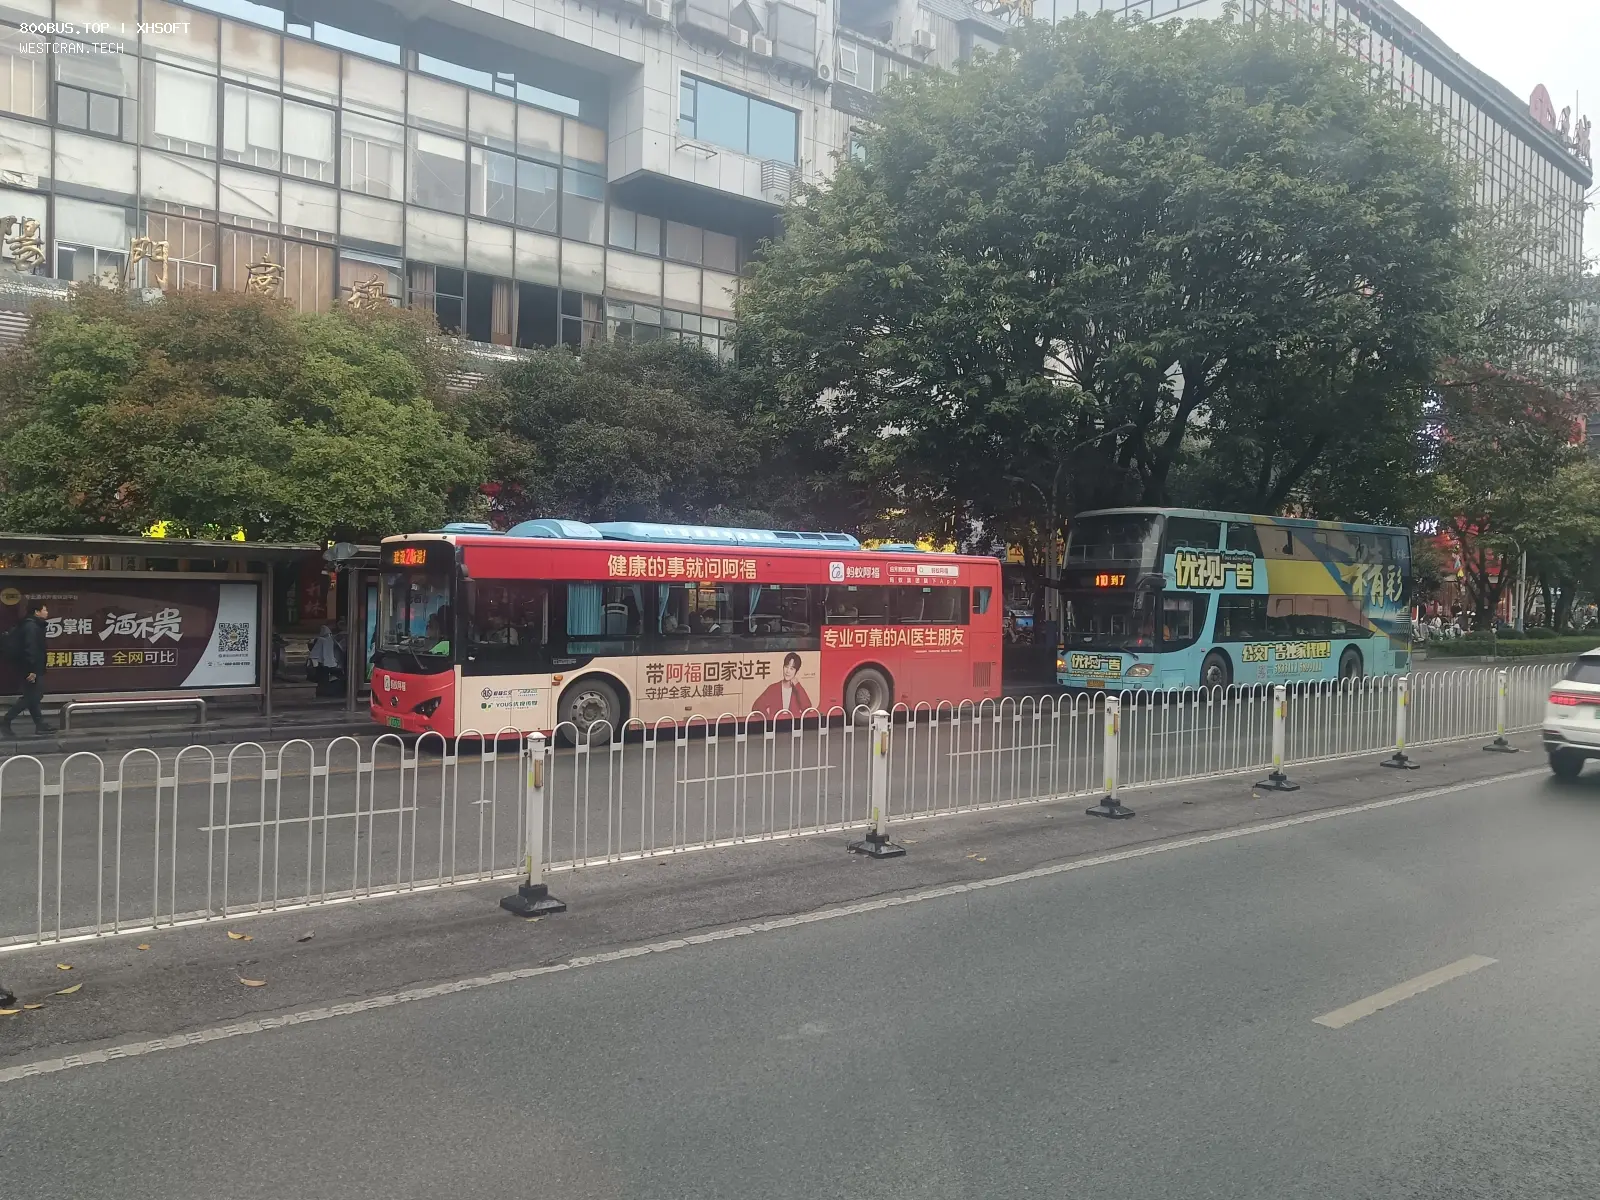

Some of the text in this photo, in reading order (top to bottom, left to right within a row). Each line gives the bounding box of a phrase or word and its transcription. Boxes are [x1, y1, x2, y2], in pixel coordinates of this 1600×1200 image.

[607, 554, 757, 579] 健康的事就问阿福
[846, 566, 880, 579] 蚂蚁阿福
[1175, 552, 1253, 588] 优视广告
[1110, 574, 1126, 586] 到了
[98, 608, 183, 644] 酒不贵
[823, 628, 965, 648] 专业可靠的AI医生朋友
[111, 650, 175, 664] 全网可比
[1072, 655, 1121, 670] 优视广告
[646, 660, 771, 684] 带阿福回家过年
[645, 684, 724, 700] 守护全家人健康
